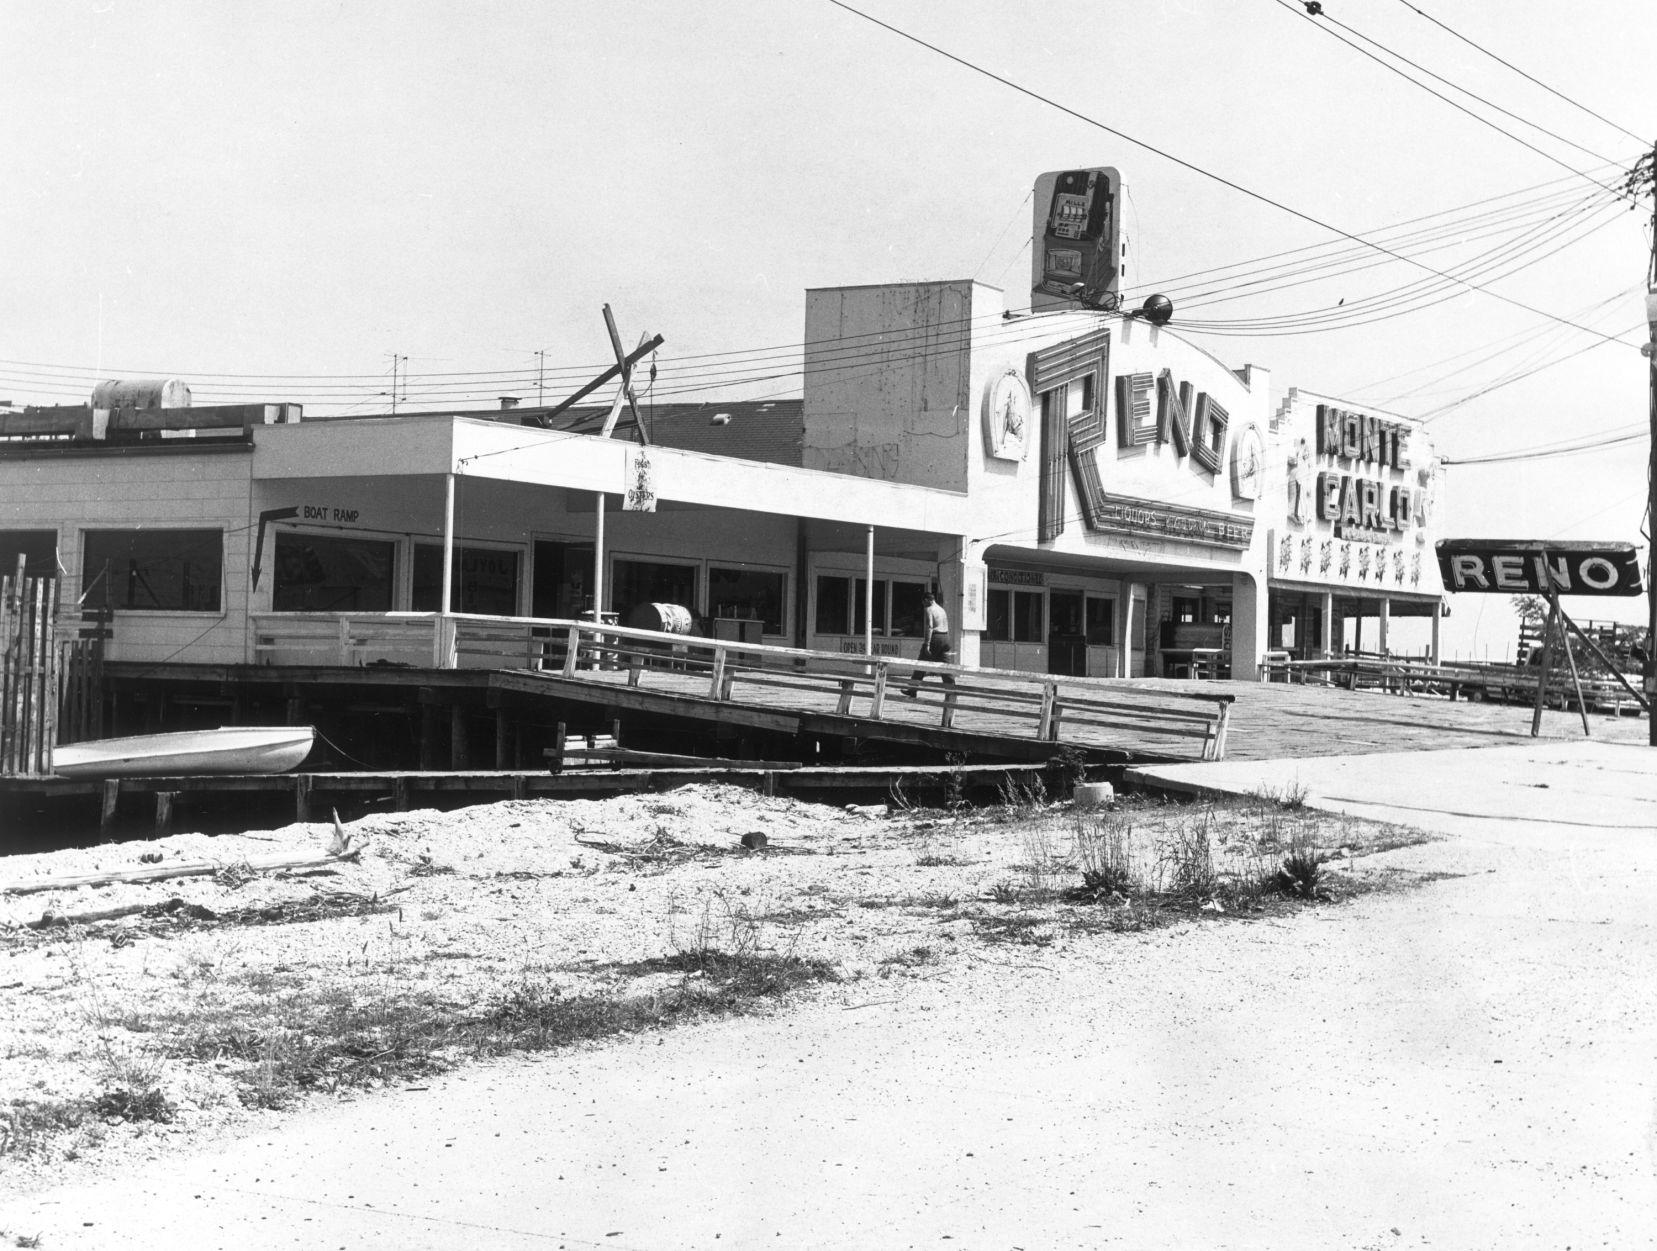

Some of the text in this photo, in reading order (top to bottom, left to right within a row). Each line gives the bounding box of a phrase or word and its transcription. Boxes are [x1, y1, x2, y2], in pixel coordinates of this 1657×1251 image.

[1026, 328, 1255, 551] RENO
[1316, 404, 1412, 470] MONTE
[304, 505, 360, 523] BOAT RAMP
[1115, 505, 1157, 526] LIQUORS
[1218, 522, 1250, 540] BEER
[1316, 472, 1411, 531] CARLO
[1451, 555, 1619, 591] RENO
